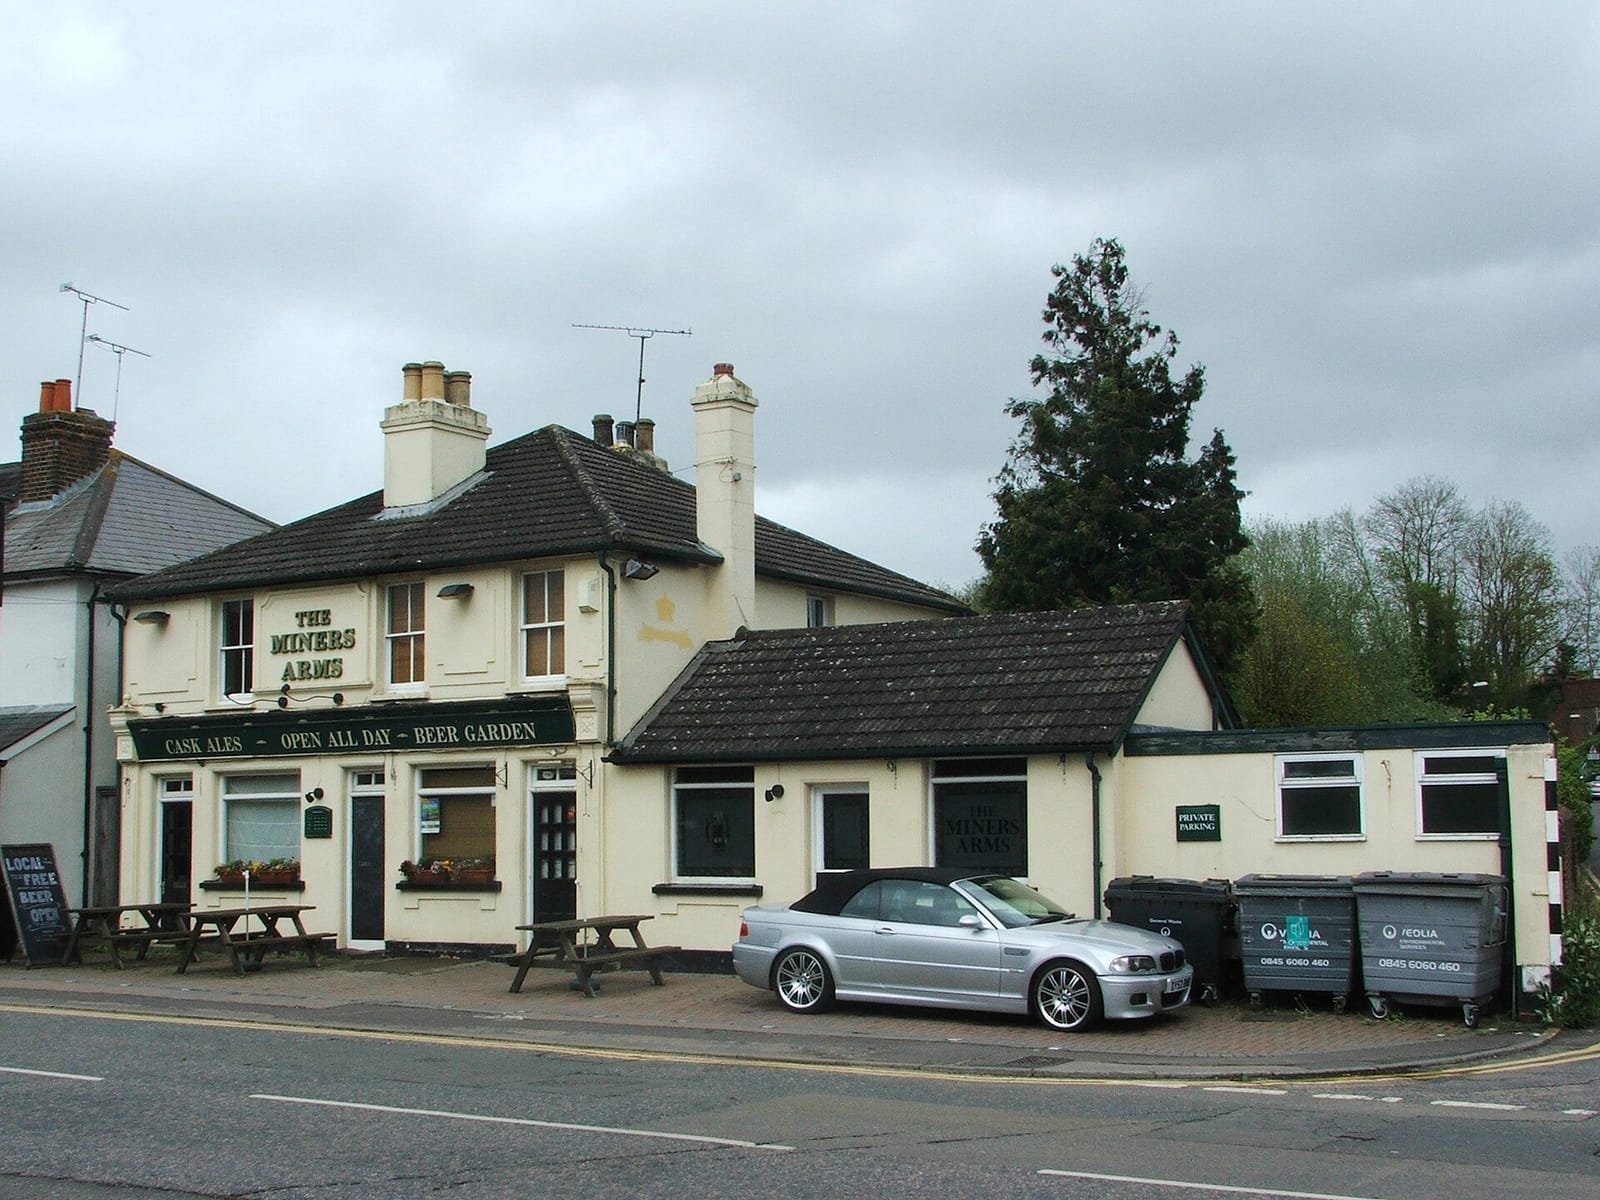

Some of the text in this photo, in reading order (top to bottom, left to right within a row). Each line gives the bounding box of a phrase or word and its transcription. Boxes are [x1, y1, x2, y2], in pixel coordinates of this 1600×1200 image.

[295, 609, 331, 627] THE
[270, 628, 356, 654] MINERS
[281, 658, 343, 681] ARMS
[165, 722, 537, 754] CASK ALES OPEN ALL DAY BEER GARDEN
[1179, 813, 1216, 822] PRIVATE
[945, 819, 1020, 836] MINERS
[1180, 822, 1216, 831] PARKING
[956, 837, 1010, 853] ARMS
[5, 856, 45, 871] LOCAL
[23, 872, 58, 886] FREE
[19, 889, 54, 904] BEER
[30, 908, 61, 923] OPEN
[1278, 929, 1321, 939] VIA
[1260, 957, 1330, 967] 0845 6060 460
[1378, 958, 1461, 972] 0845 6060 460
